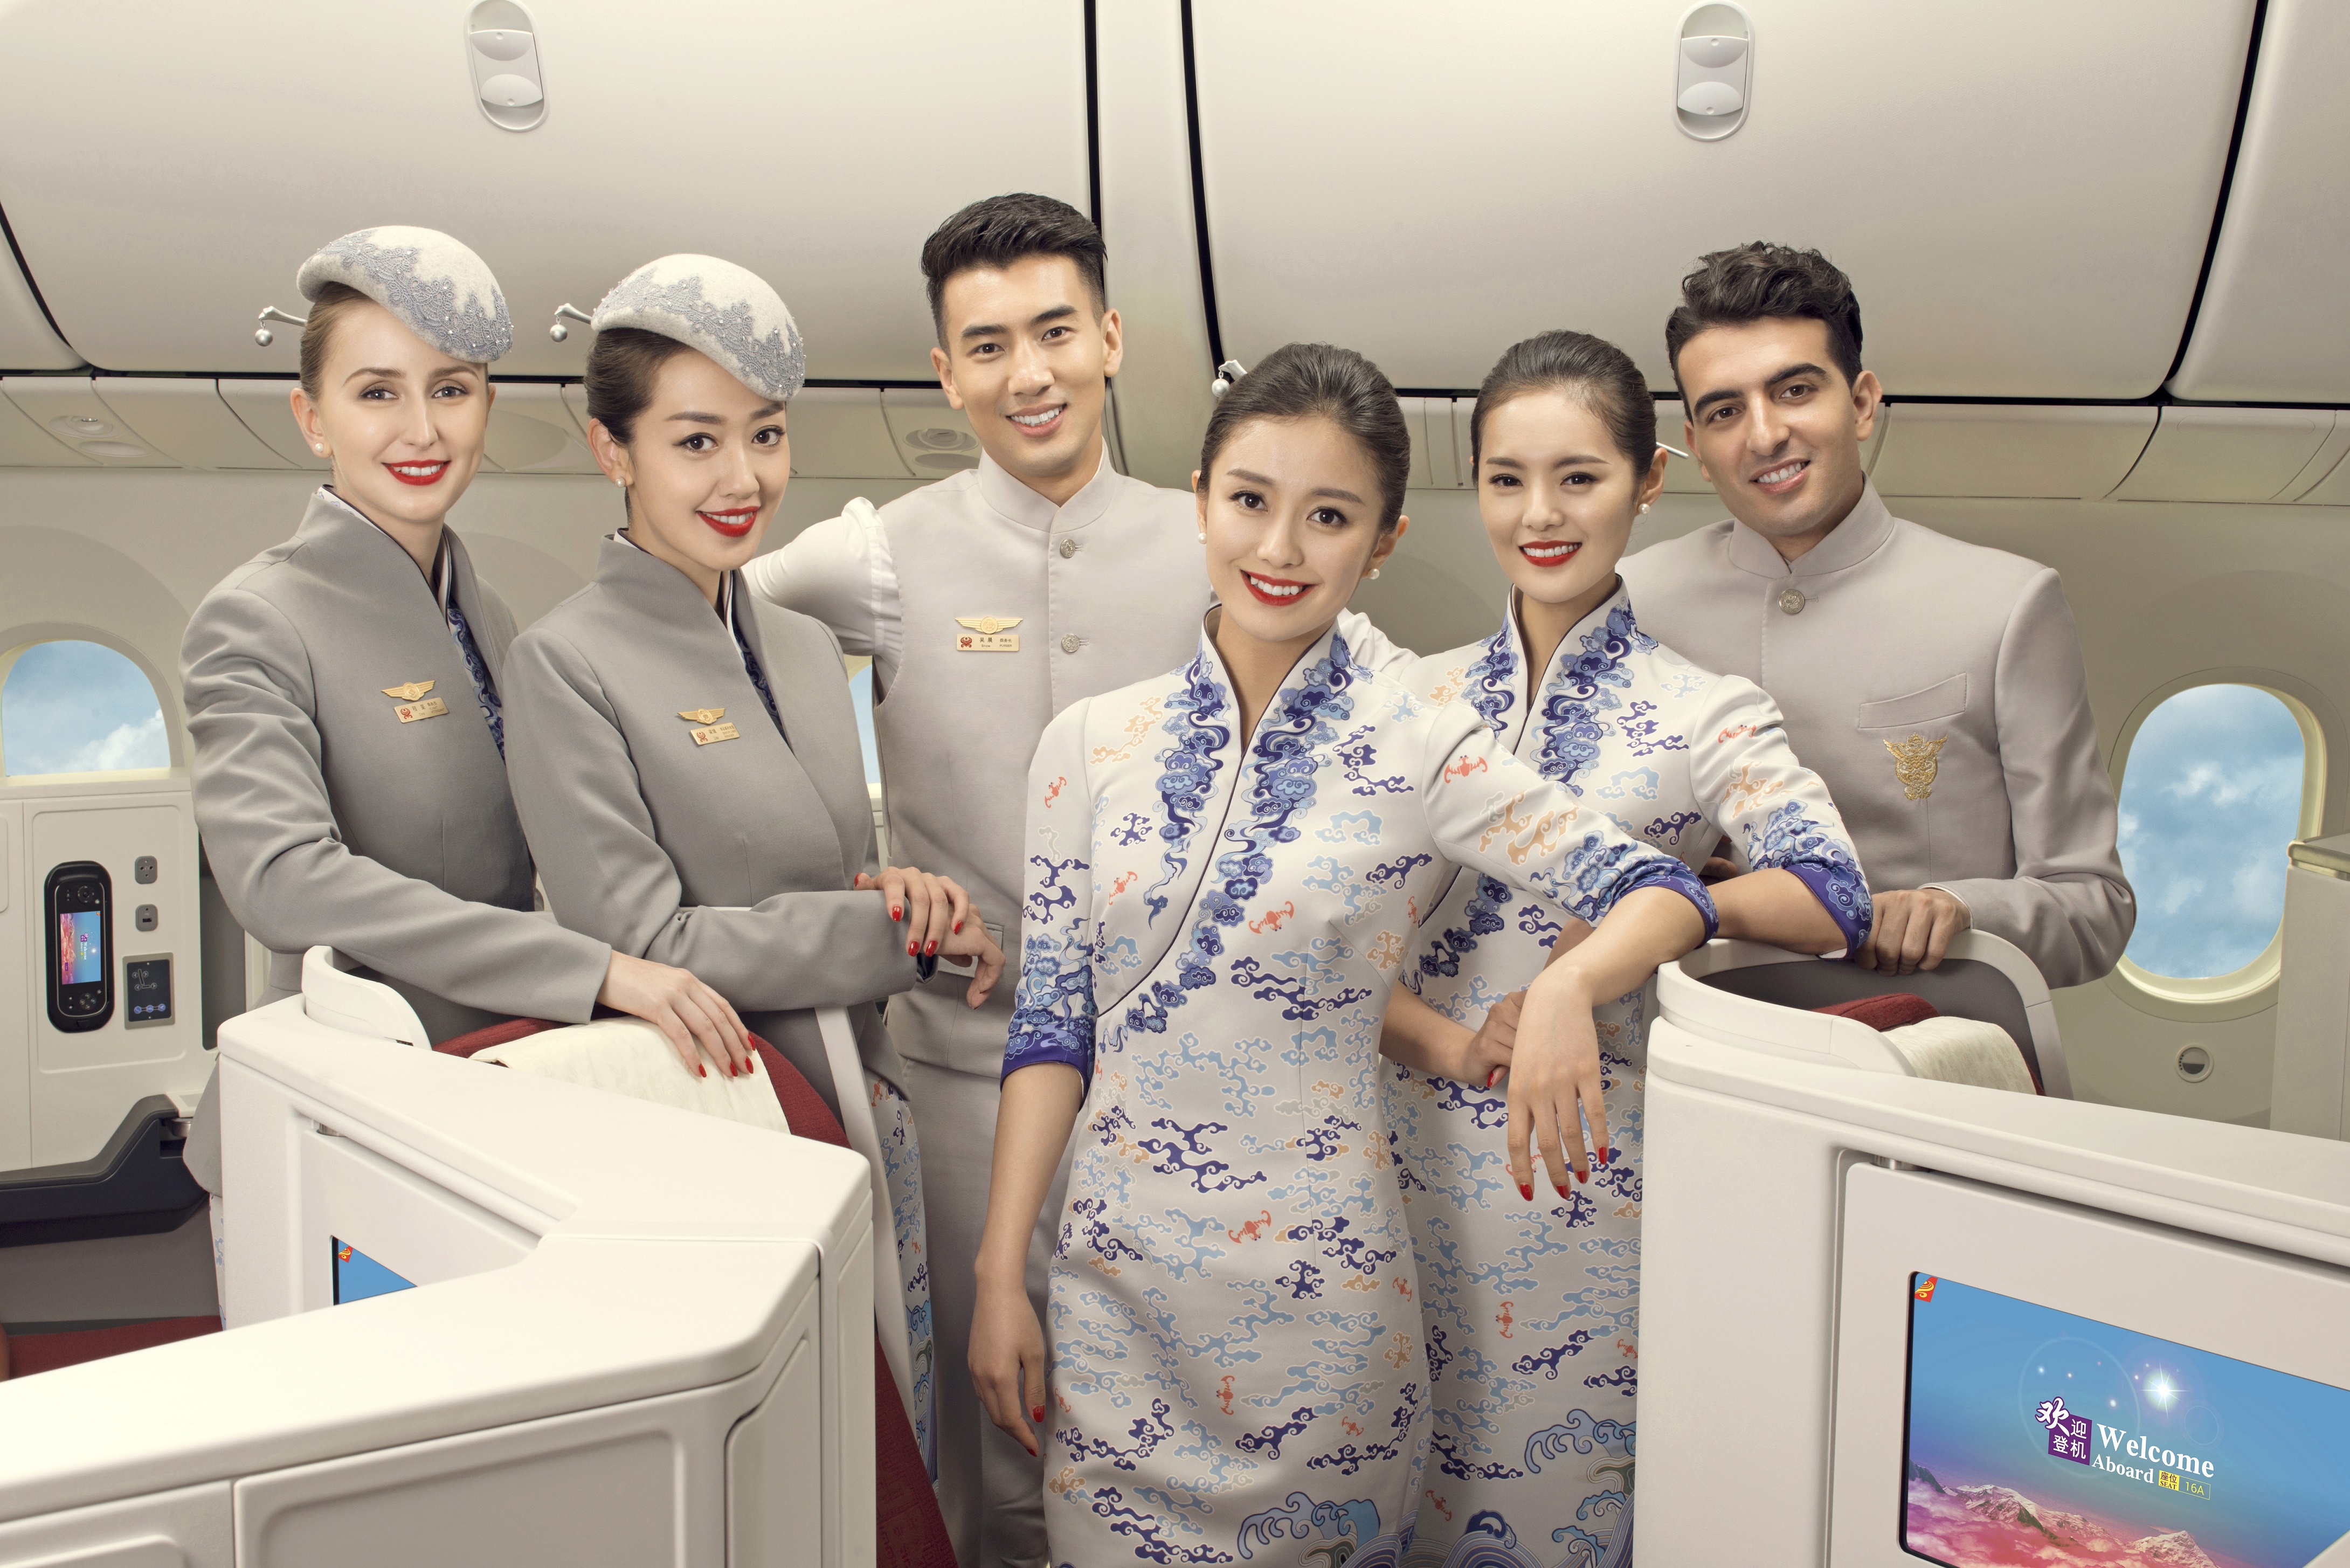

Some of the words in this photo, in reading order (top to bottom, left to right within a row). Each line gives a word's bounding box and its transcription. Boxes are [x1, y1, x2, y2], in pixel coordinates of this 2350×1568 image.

[2097, 1424, 2214, 1478] Welcome
[2092, 1454, 2154, 1483] Aboard
[2160, 1472, 2178, 1484] 座位
[2160, 1481, 2177, 1490] SEAT
[2186, 1482, 2204, 1496] 16A
